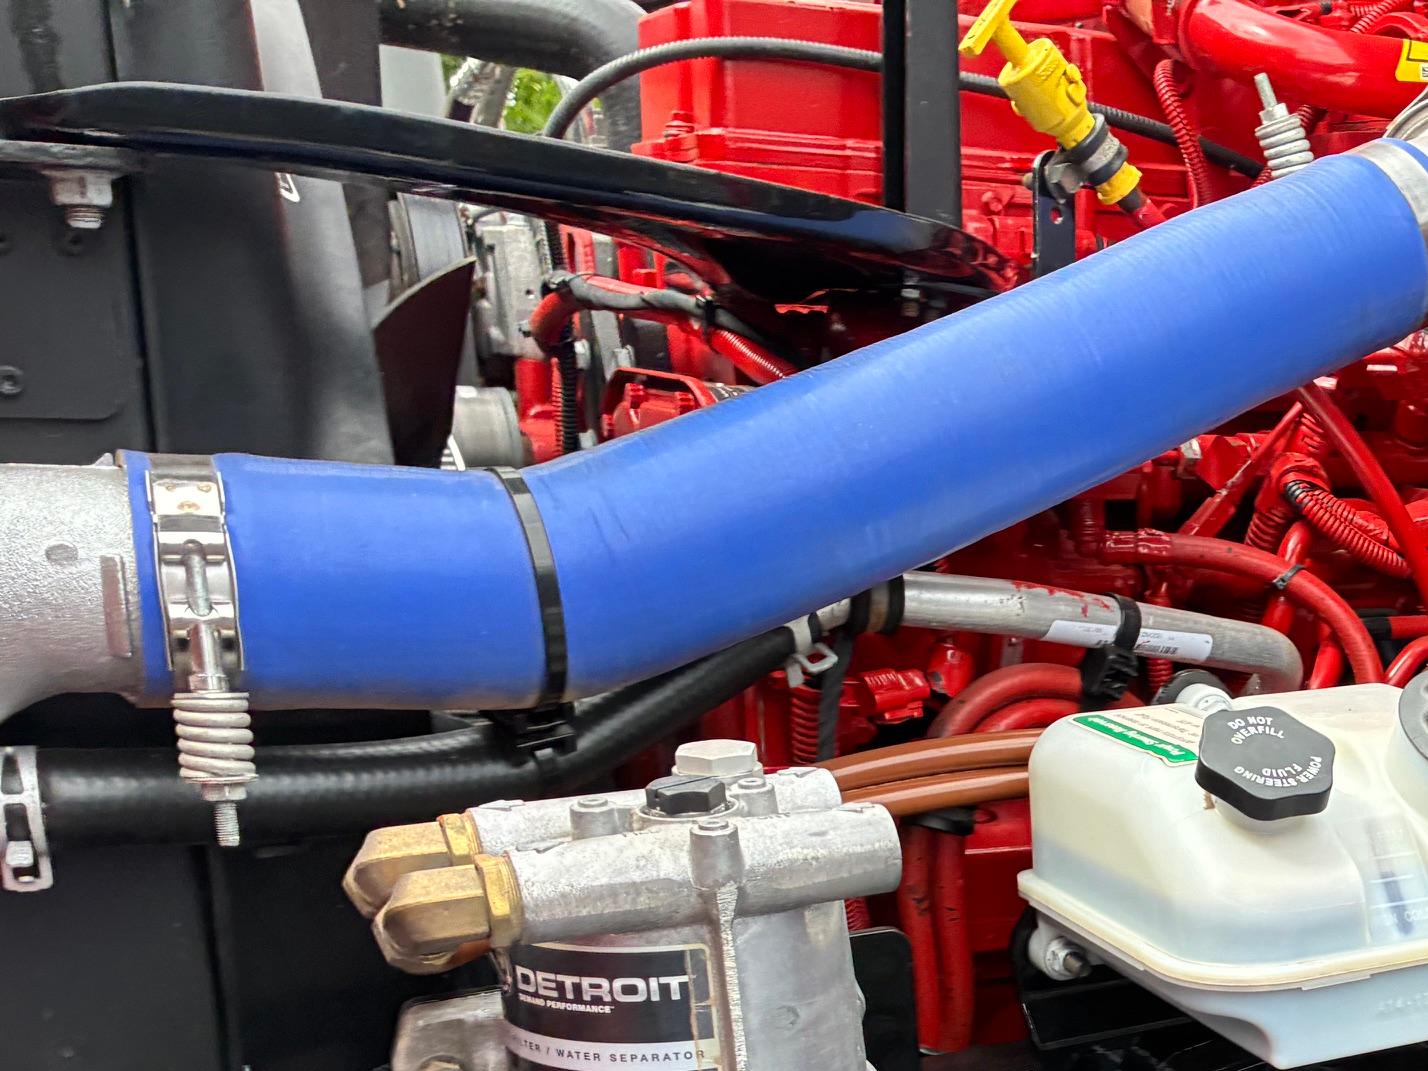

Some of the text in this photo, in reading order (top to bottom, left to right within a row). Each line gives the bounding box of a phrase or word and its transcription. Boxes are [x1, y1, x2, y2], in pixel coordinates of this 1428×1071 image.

[1227, 716, 1273, 730] DO NOT
[1230, 725, 1285, 745] OVERFILL
[1233, 755, 1322, 787] POWER STEERING
[1262, 763, 1303, 778] FLUID
[515, 964, 690, 1003] DETROIT
[556, 1048, 600, 1061] WATER
[609, 1049, 705, 1062] SEPARATOR
